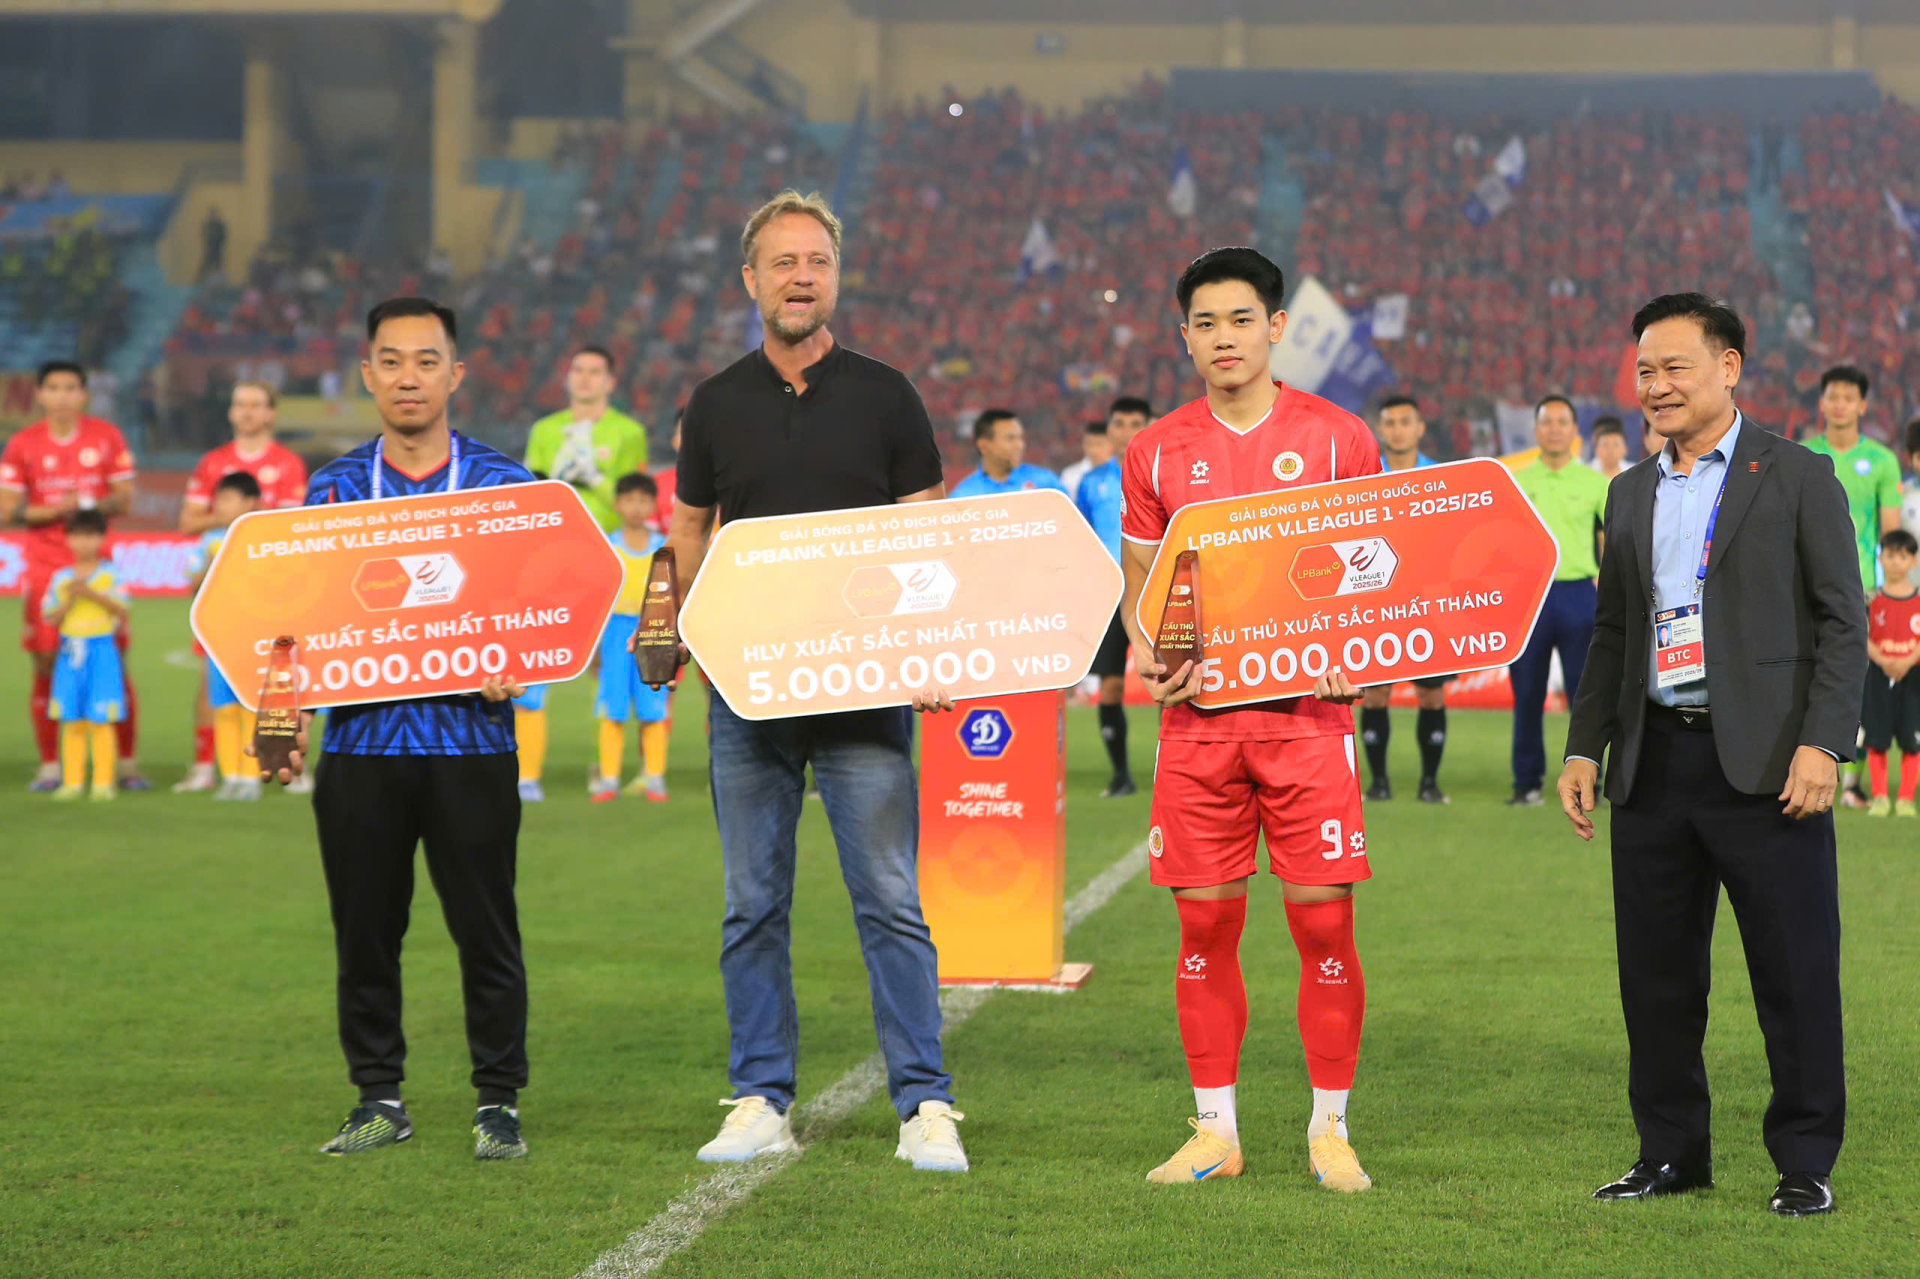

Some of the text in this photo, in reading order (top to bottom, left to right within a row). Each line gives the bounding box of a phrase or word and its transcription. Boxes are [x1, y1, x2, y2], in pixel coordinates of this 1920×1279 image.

[291, 499, 517, 533] GIẢI BÓNG ĐÁ VÔ ĐỊCH QUỐC GIA
[1229, 480, 1447, 522] GIẢI BÓNG ĐÁ VÔ ĐỊCH QUỐC GIA
[247, 534, 337, 559] LPBANK
[342, 524, 446, 549] V.LEAGUE
[450, 523, 462, 538] 1
[477, 511, 563, 535] 2025/26
[779, 507, 1009, 541] GIẢI BÓNG ĐÁ VÔ ĐỊCH QUỐC GIA
[1187, 524, 1273, 551] LPBANK
[1277, 507, 1378, 537] V.LEAGUE
[1382, 506, 1394, 522] 1
[1409, 490, 1494, 518] 2025/26
[735, 543, 826, 567] LPBANK
[830, 532, 937, 557] V.LEAGUE
[941, 531, 954, 547] 1
[969, 519, 1057, 543] 2025/26
[1297, 567, 1332, 580] LPBank
[1349, 572, 1381, 583] V.LEAGUE
[1352, 580, 1383, 590] 2025/26
[305, 624, 366, 651] XUẤT
[371, 618, 418, 644] SẮC
[424, 611, 485, 639] NHẤT
[490, 607, 570, 632] THÁNG
[648, 619, 665, 627] HLV
[743, 613, 1067, 663] HLV XUẤT SẮC NHẤT THÁNG
[1202, 590, 1503, 648] CẦU THỦ XUẤT SẮC NHẤT THÁNG
[519, 648, 573, 670] VNĐ
[1202, 627, 1434, 692] 5.000.000
[1449, 631, 1507, 657] VNĐ
[1667, 648, 1691, 664] BTC
[749, 648, 1071, 705] 5.000.000 VNĐ
[943, 800, 1023, 818] TOGETHER
[959, 782, 1007, 799] SHINE
[1320, 818, 1344, 861] 9
